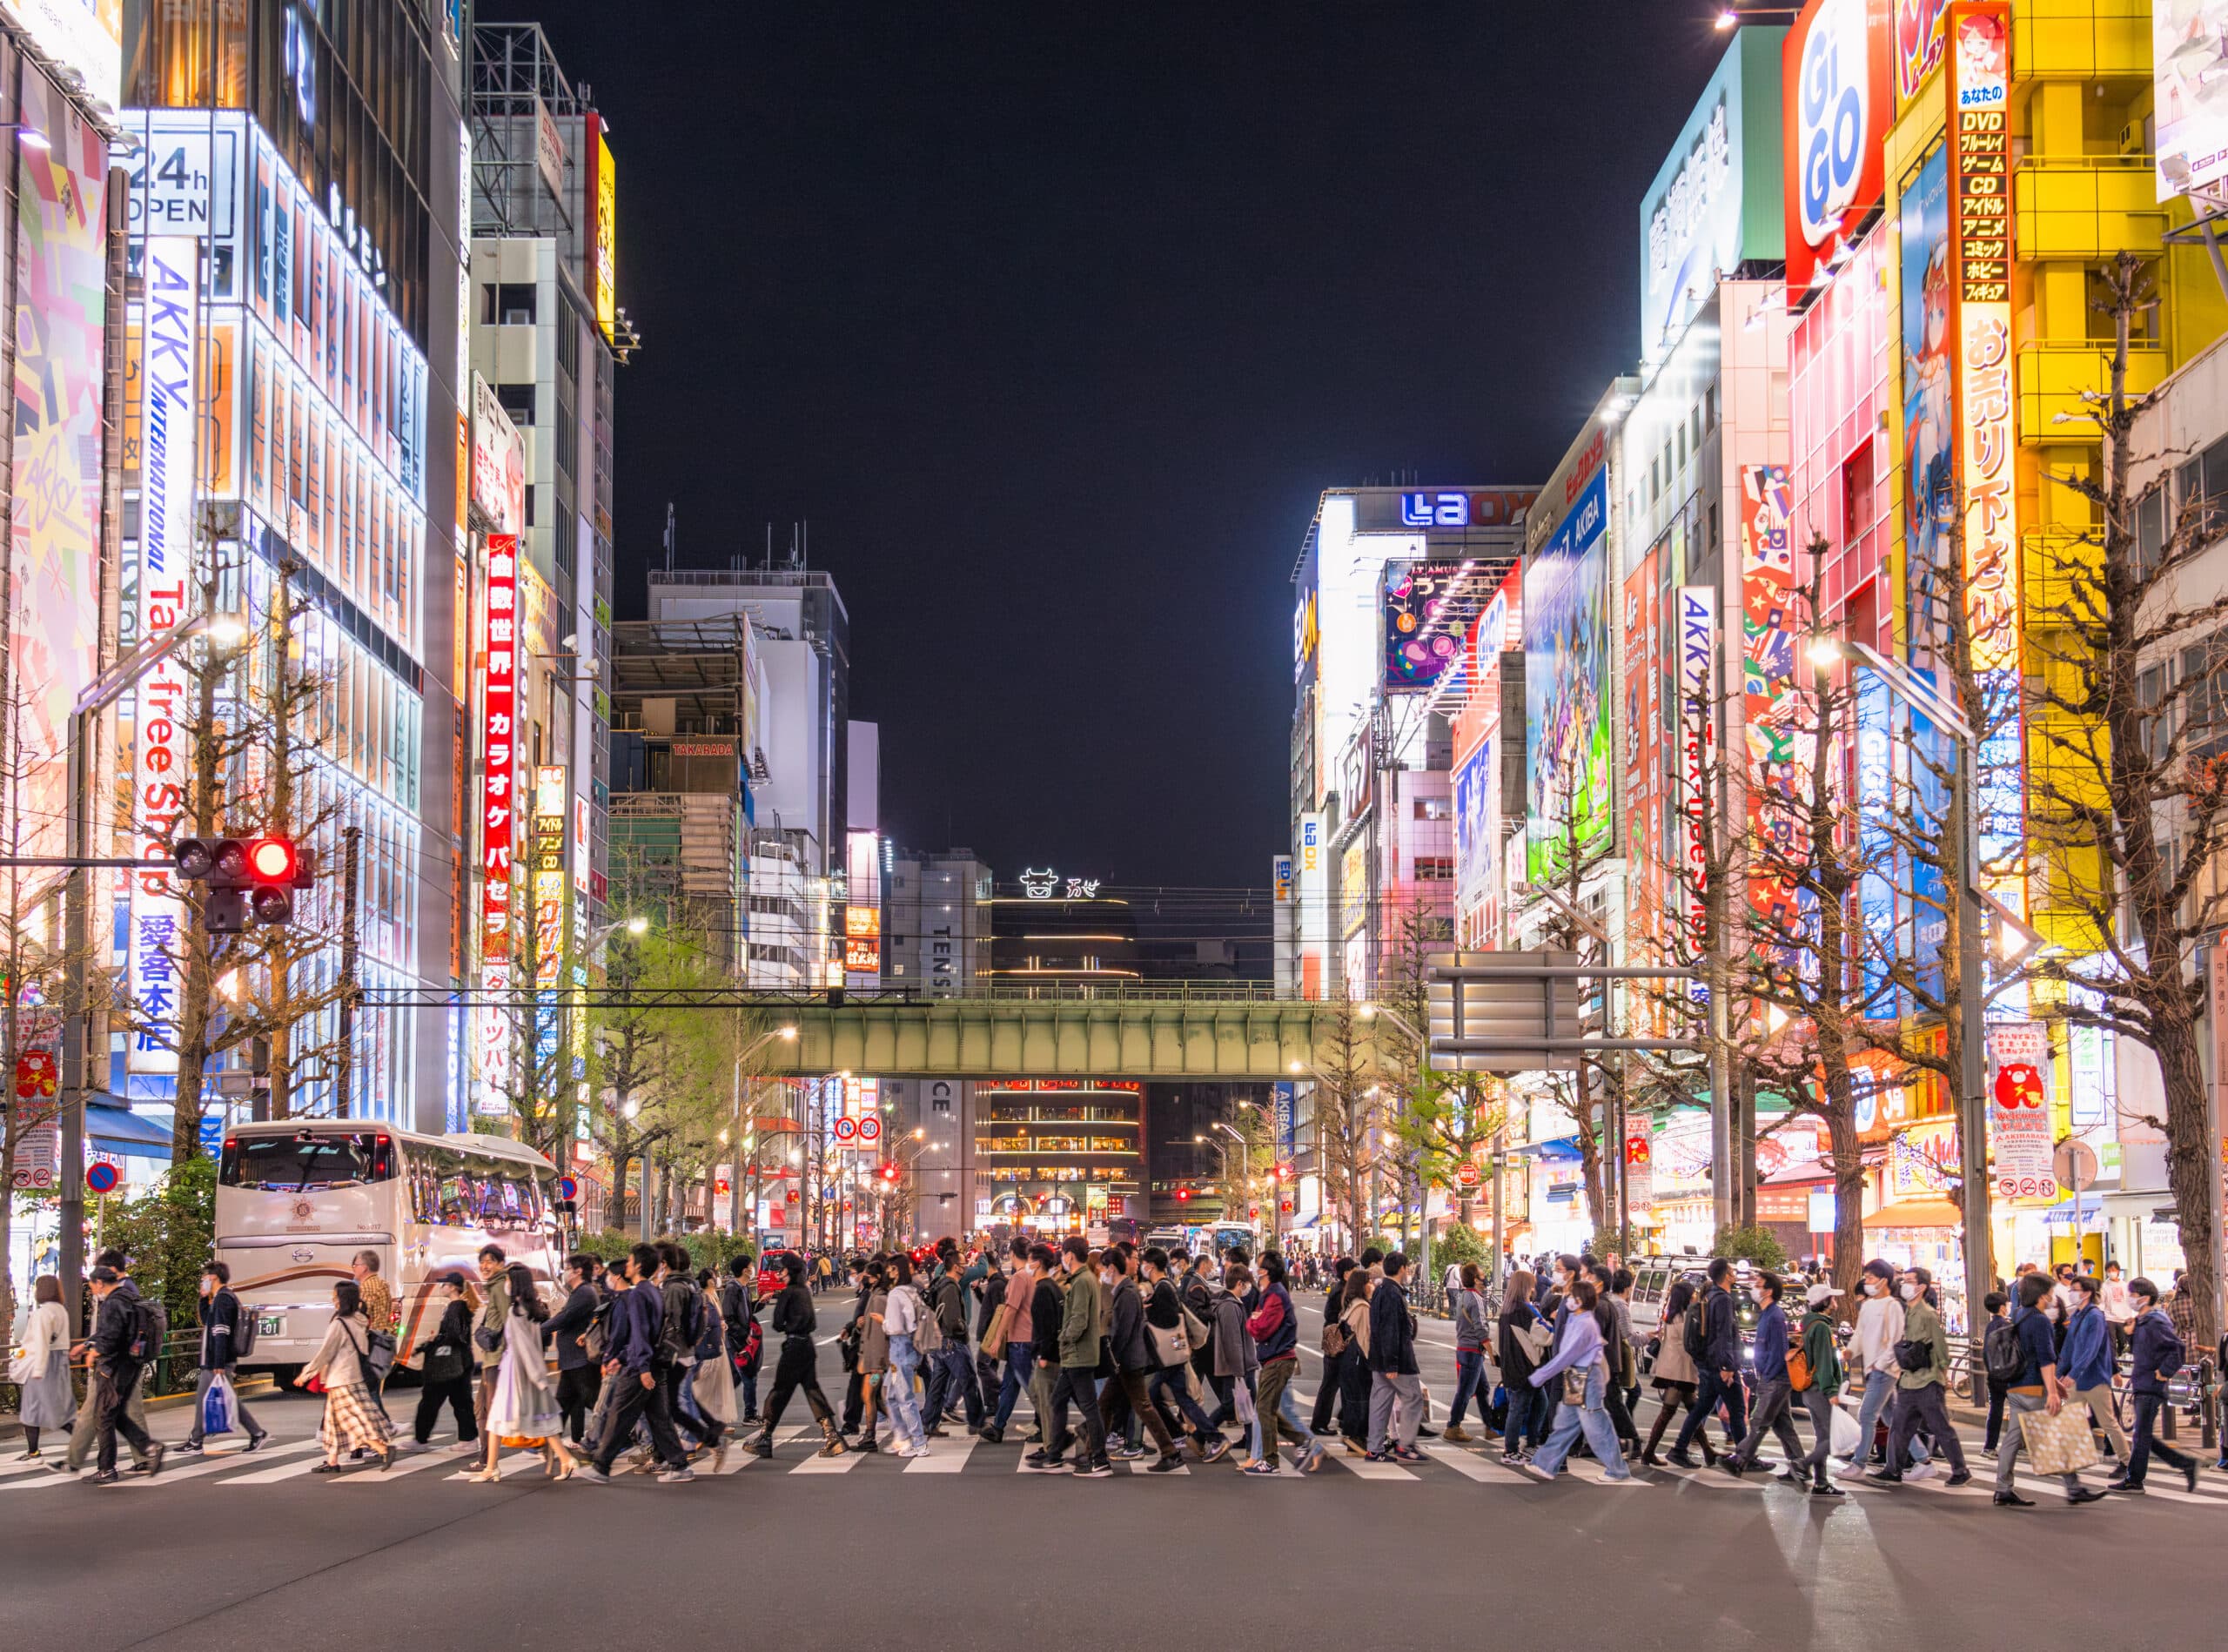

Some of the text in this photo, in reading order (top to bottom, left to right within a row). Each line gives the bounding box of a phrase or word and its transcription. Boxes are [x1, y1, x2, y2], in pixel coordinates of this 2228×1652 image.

[1961, 85, 2003, 104] あなたの
[1963, 111, 2003, 131] DVD
[130, 145, 207, 191] 24h
[1962, 155, 2004, 173] ゲーム
[1970, 176, 1997, 194] CD
[1963, 198, 2004, 216] アイドル
[1963, 218, 2005, 238] アニメ
[1964, 239, 2004, 259] コミック
[1966, 261, 2004, 279] ホビー
[1965, 284, 2005, 301] フィギュア
[151, 254, 189, 412] AKKY
[148, 381, 168, 574] INTERNATIONAL
[1575, 494, 1600, 547] AKIBA
[486, 554, 513, 934] 曲数世界一 カラオケ パセラ
[673, 743, 734, 756] TAKARADA
[538, 817, 564, 832] アイドル
[538, 836, 563, 850] アニメ
[542, 855, 558, 870] CD
[1066, 878, 1101, 898] 万世
[137, 914, 176, 1052] 愛客本店
[2217, 962, 2226, 1016] 中央通り
[1278, 1090, 1291, 1138] AKIBA
[862, 1123, 876, 1135] 50
[2004, 1132, 2050, 1141] AKIHABARA
